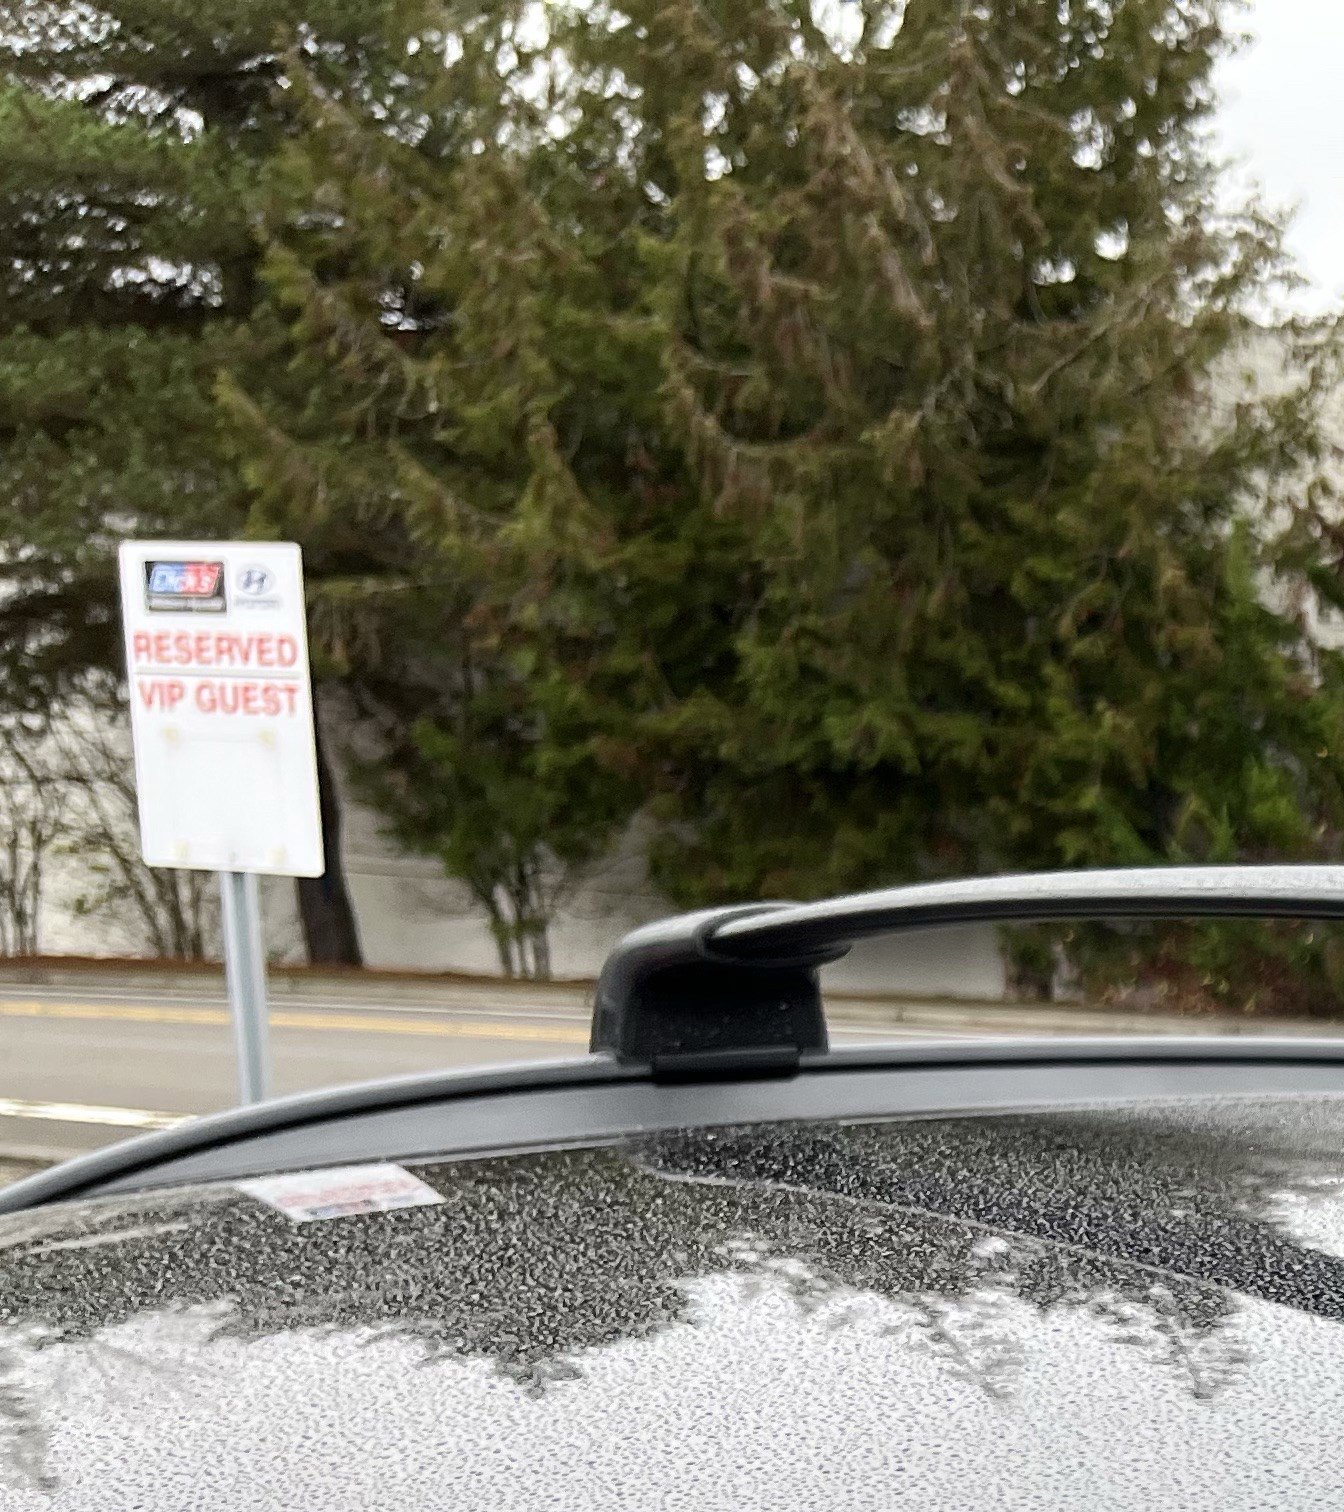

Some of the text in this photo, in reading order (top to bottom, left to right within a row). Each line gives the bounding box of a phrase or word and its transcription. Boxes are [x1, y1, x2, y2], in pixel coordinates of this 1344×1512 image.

[133, 630, 298, 667] RESERVED
[138, 679, 300, 717] VIP GUEST
